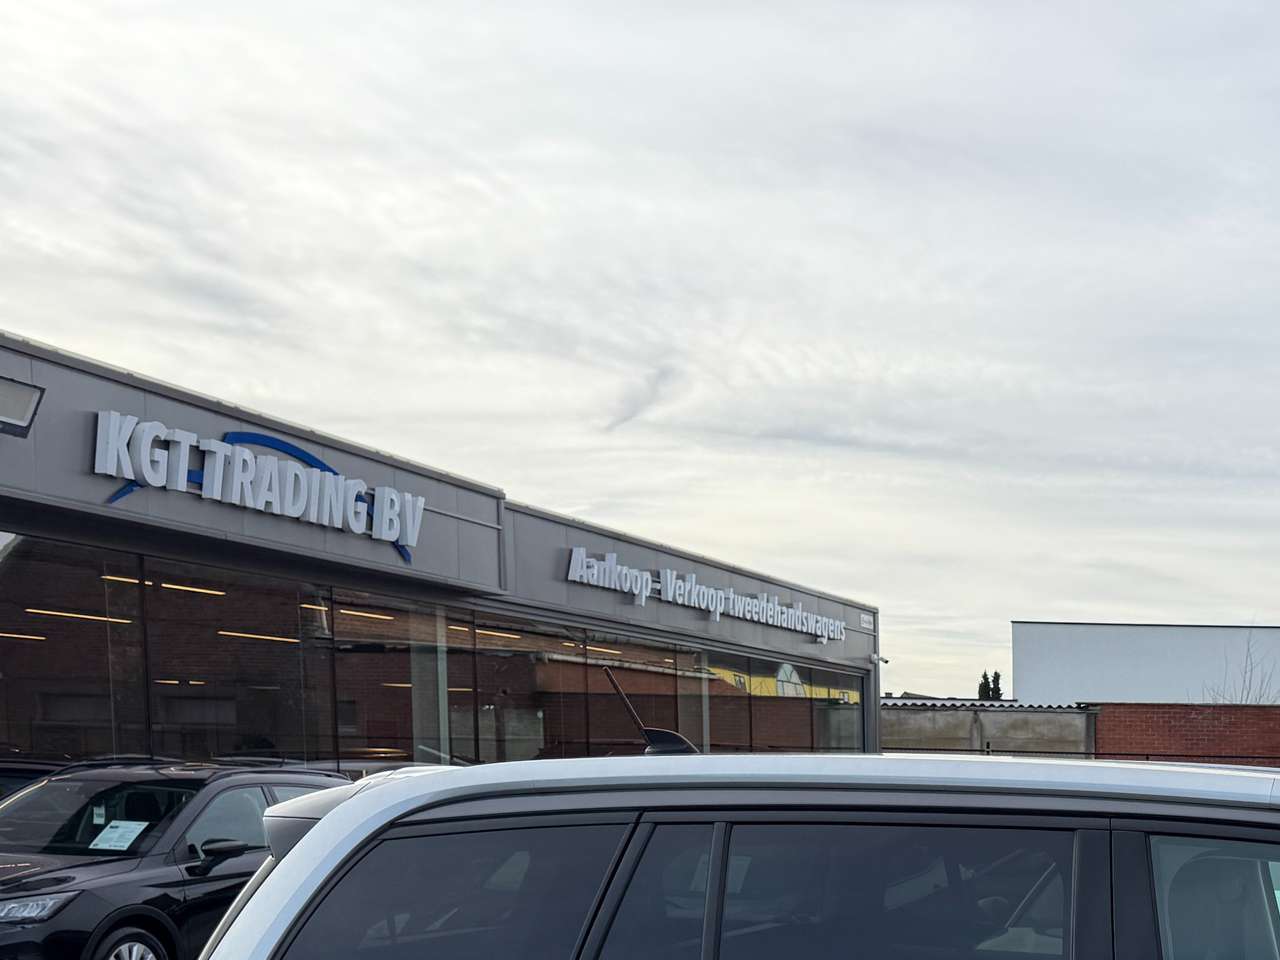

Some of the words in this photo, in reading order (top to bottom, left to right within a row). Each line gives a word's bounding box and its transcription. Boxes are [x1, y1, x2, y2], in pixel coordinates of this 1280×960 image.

[94, 410, 197, 492] KGT
[201, 438, 368, 535] TRADING
[371, 486, 426, 547] BV
[567, 547, 652, 607] Aankoop
[660, 568, 725, 622] Verkoop
[727, 587, 847, 644] tweedehandswagens
